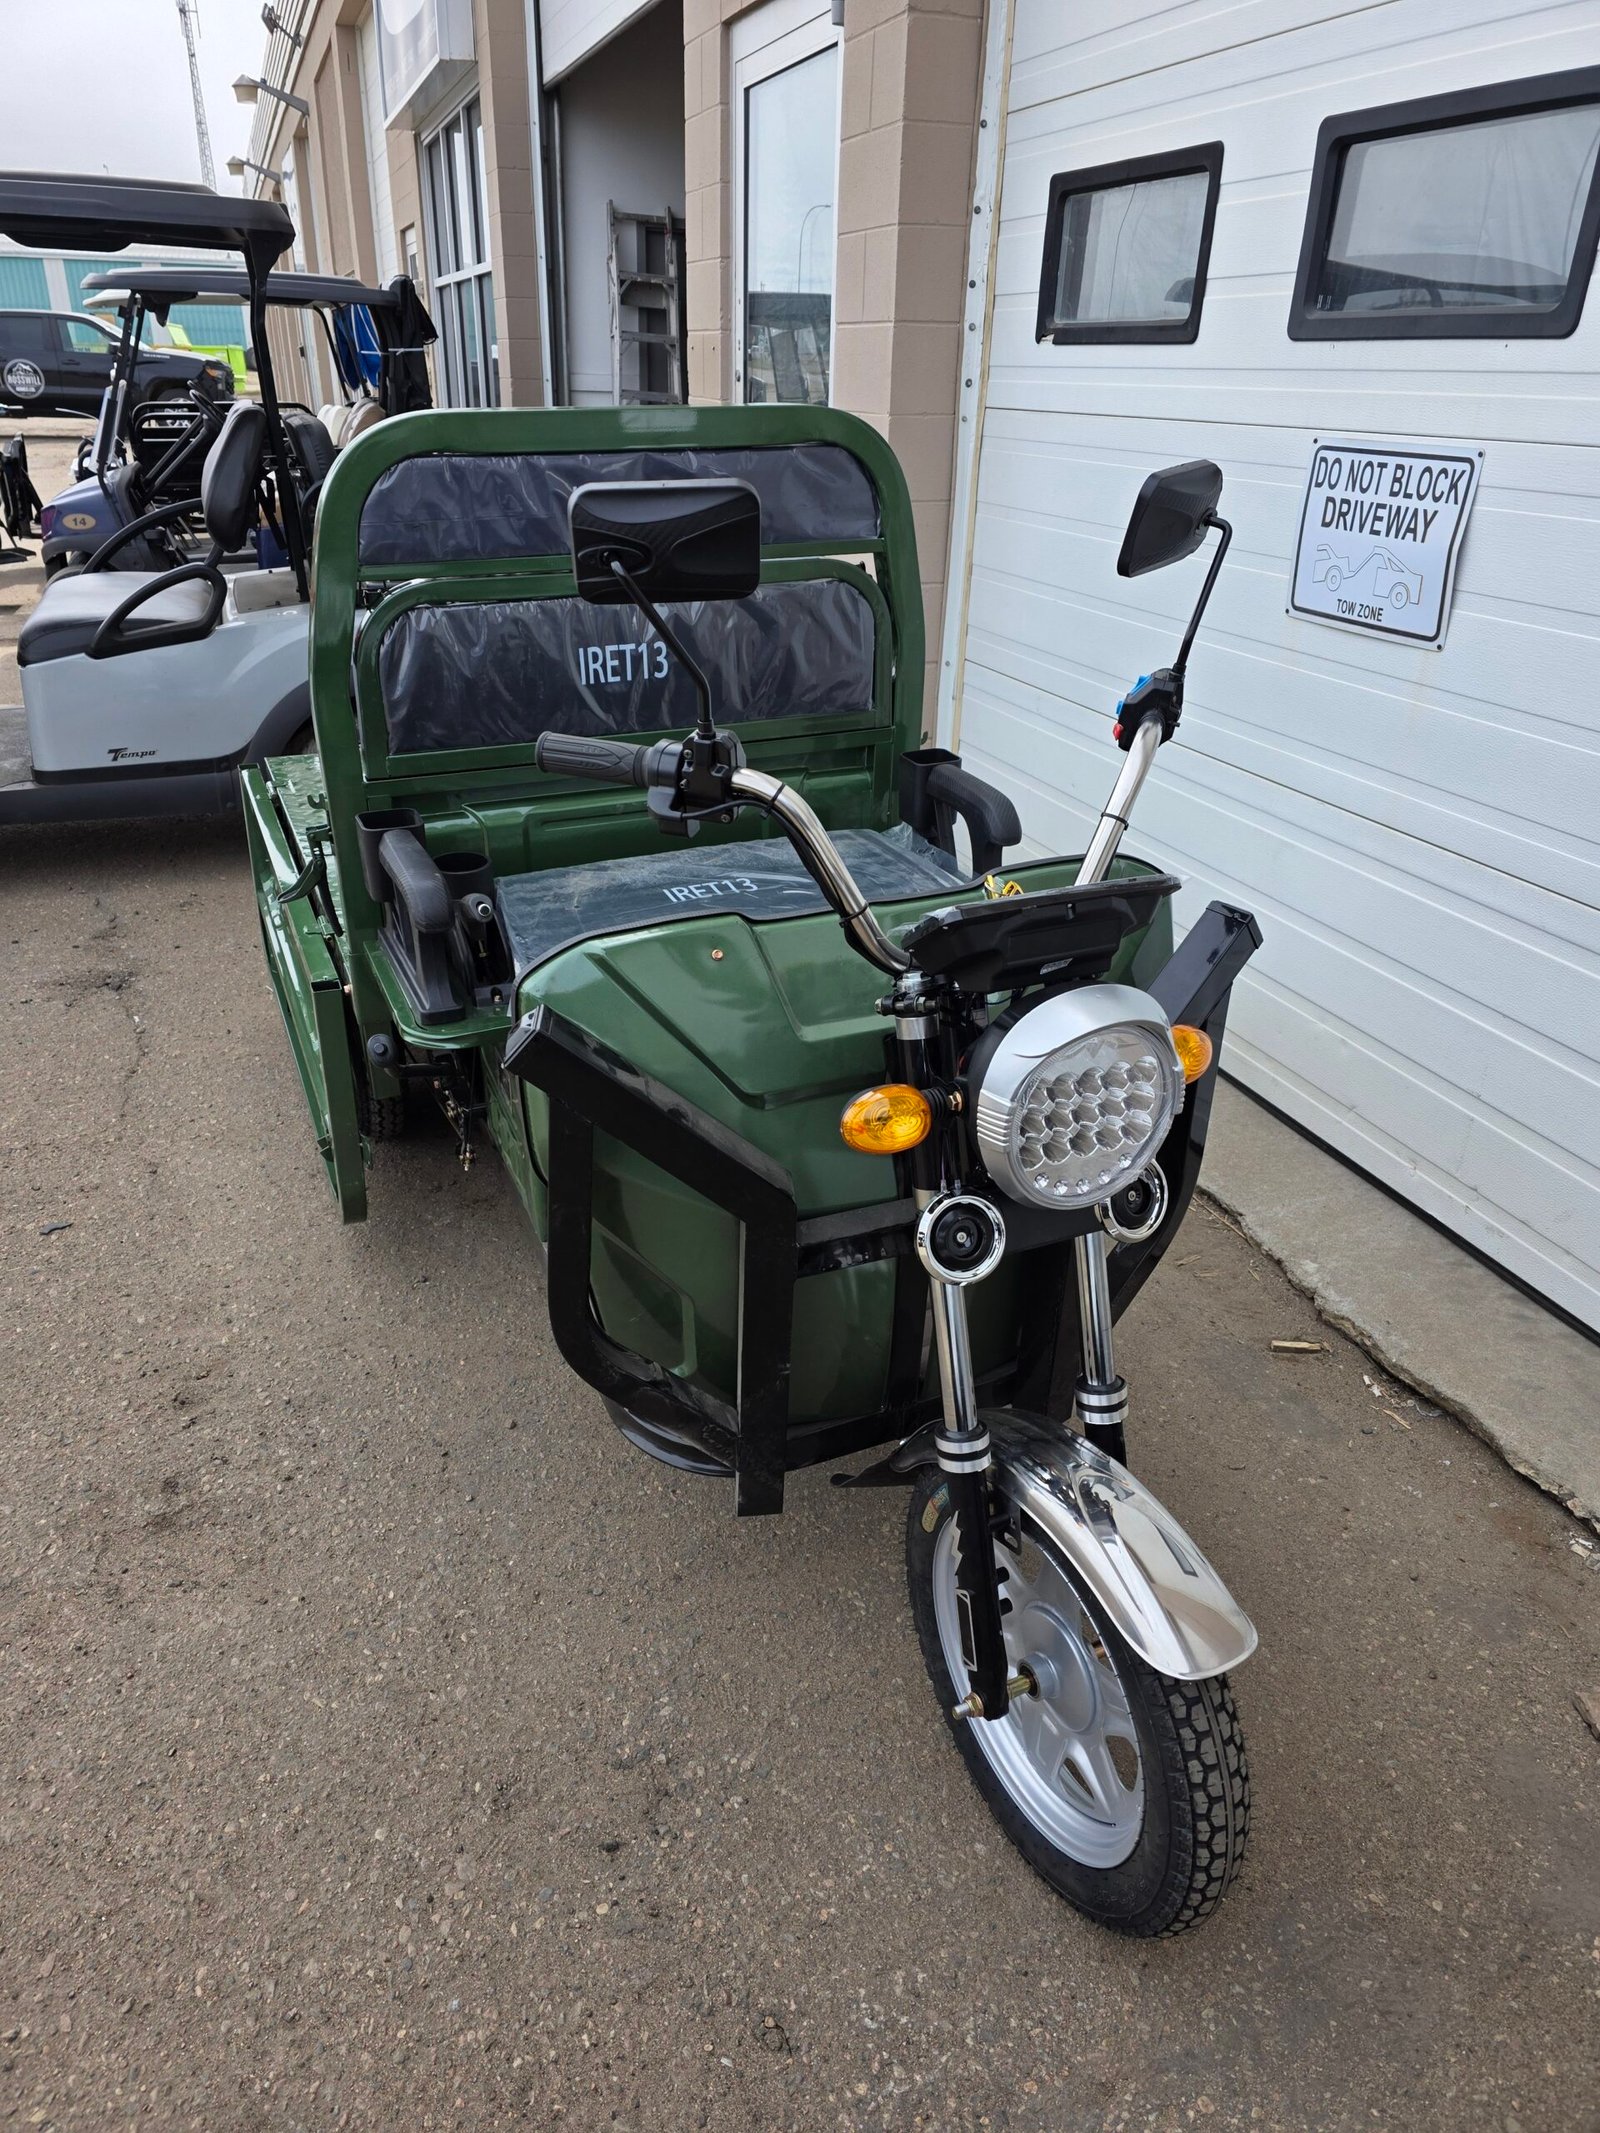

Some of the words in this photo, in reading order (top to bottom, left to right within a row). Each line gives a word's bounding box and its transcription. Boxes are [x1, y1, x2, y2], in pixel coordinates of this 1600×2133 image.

[1314, 456, 1342, 490] DO
[1345, 459, 1388, 495] NOT
[1389, 463, 1466, 505] BLOCK
[72, 517, 87, 526] 14
[1321, 496, 1438, 543] DRIVEWAY
[1337, 599, 1357, 616] TOW
[1357, 603, 1384, 622] ZONE
[579, 641, 668, 685] IRET13
[107, 747, 156, 761] Tempo
[663, 878, 758, 902] IRET13
